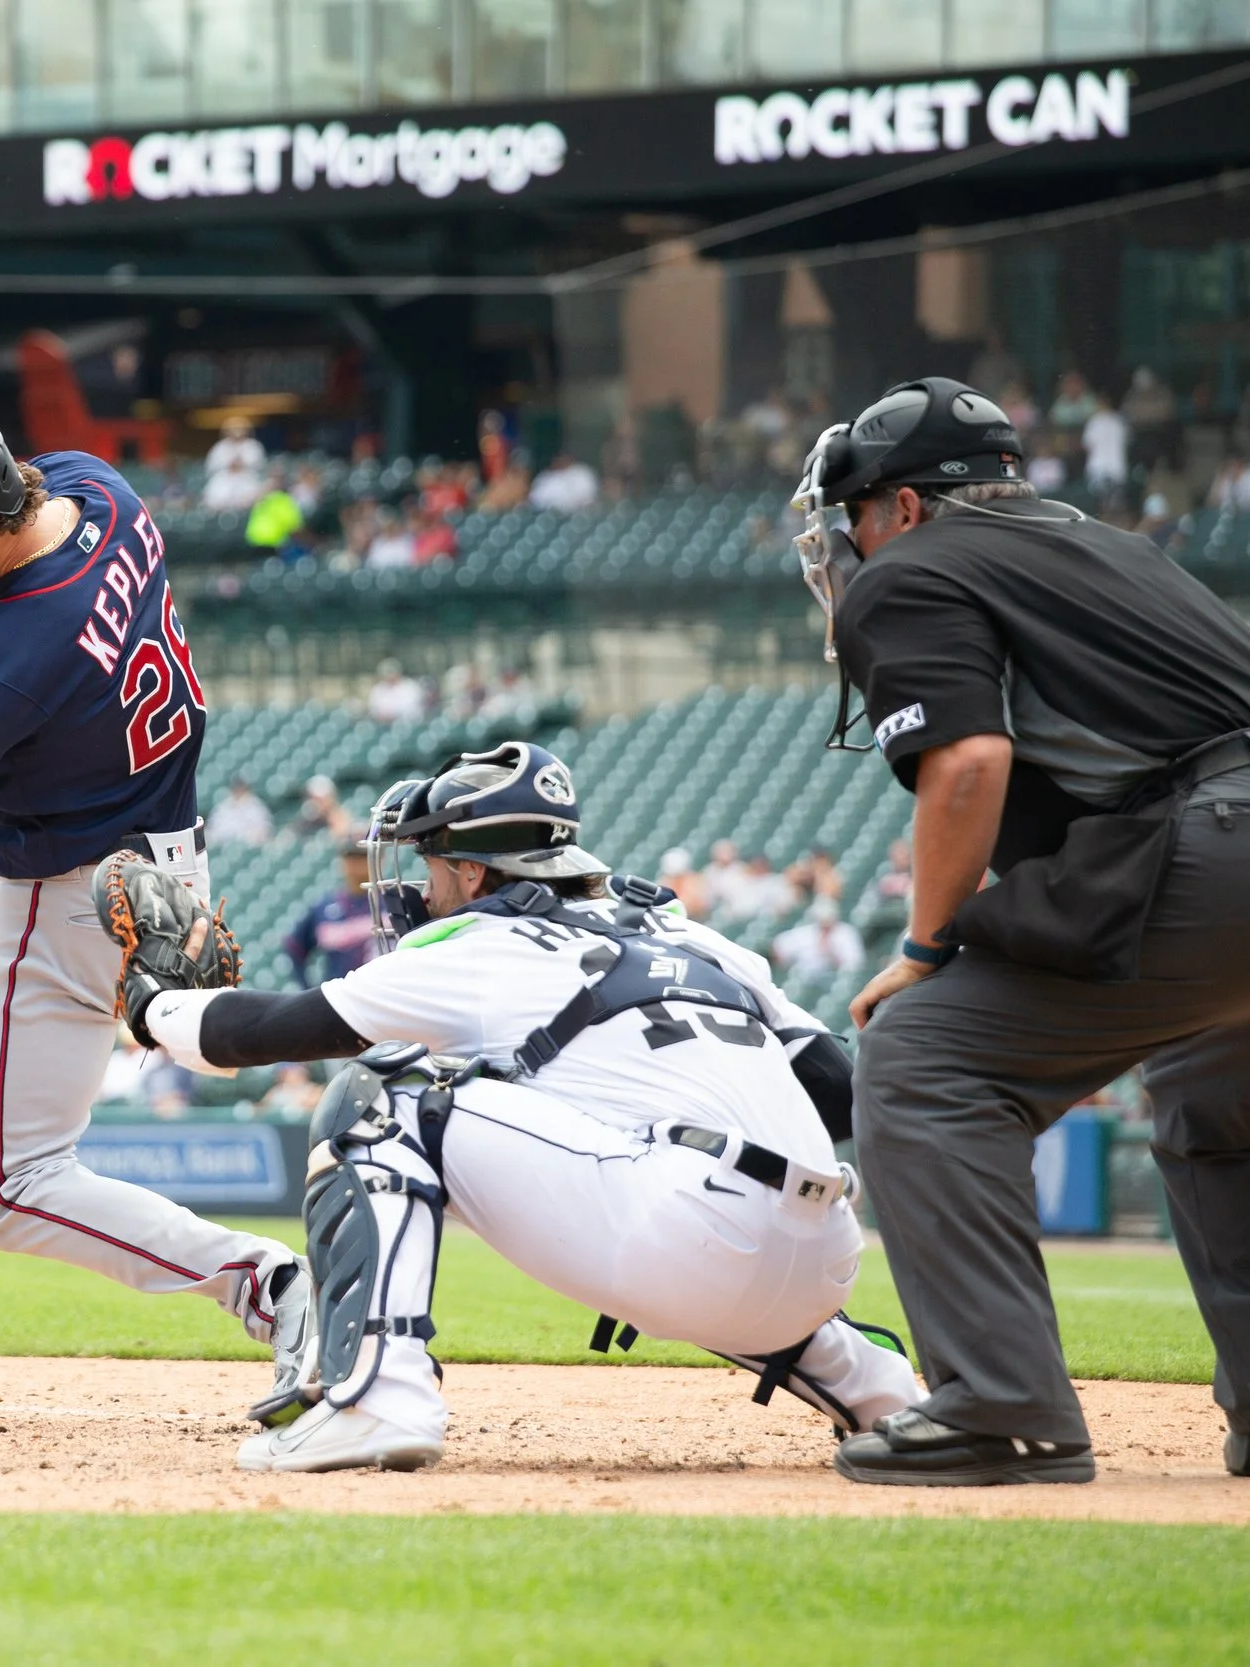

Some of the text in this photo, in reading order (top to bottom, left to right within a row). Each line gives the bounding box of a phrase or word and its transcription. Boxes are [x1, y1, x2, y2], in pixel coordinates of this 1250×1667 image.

[714, 69, 1130, 164] ROCKET CAN
[43, 120, 568, 205] ROCKET Mortgage
